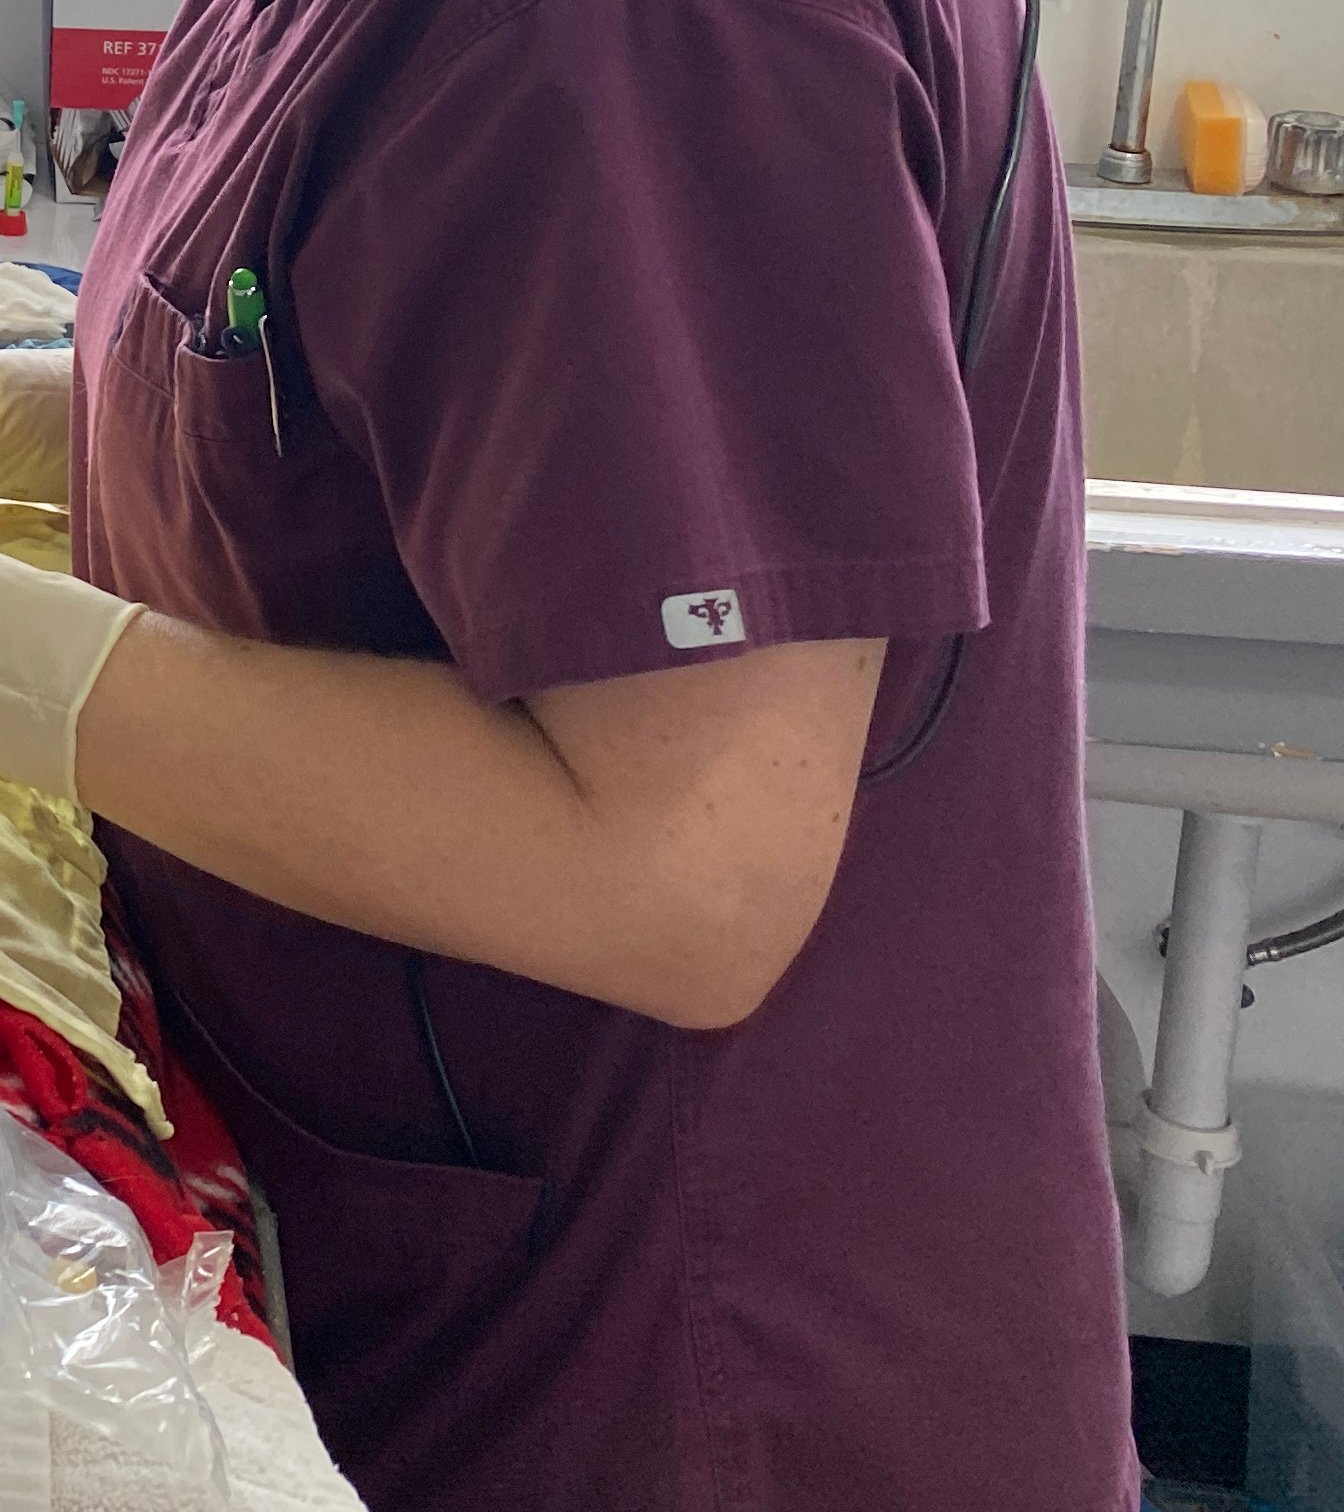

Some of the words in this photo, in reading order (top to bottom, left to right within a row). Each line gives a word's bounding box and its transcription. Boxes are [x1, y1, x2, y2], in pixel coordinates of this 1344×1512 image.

[103, 41, 133, 55] REF
[137, 42, 161, 56] 37
[102, 67, 119, 75] NDC
[119, 77, 144, 85] Patent
